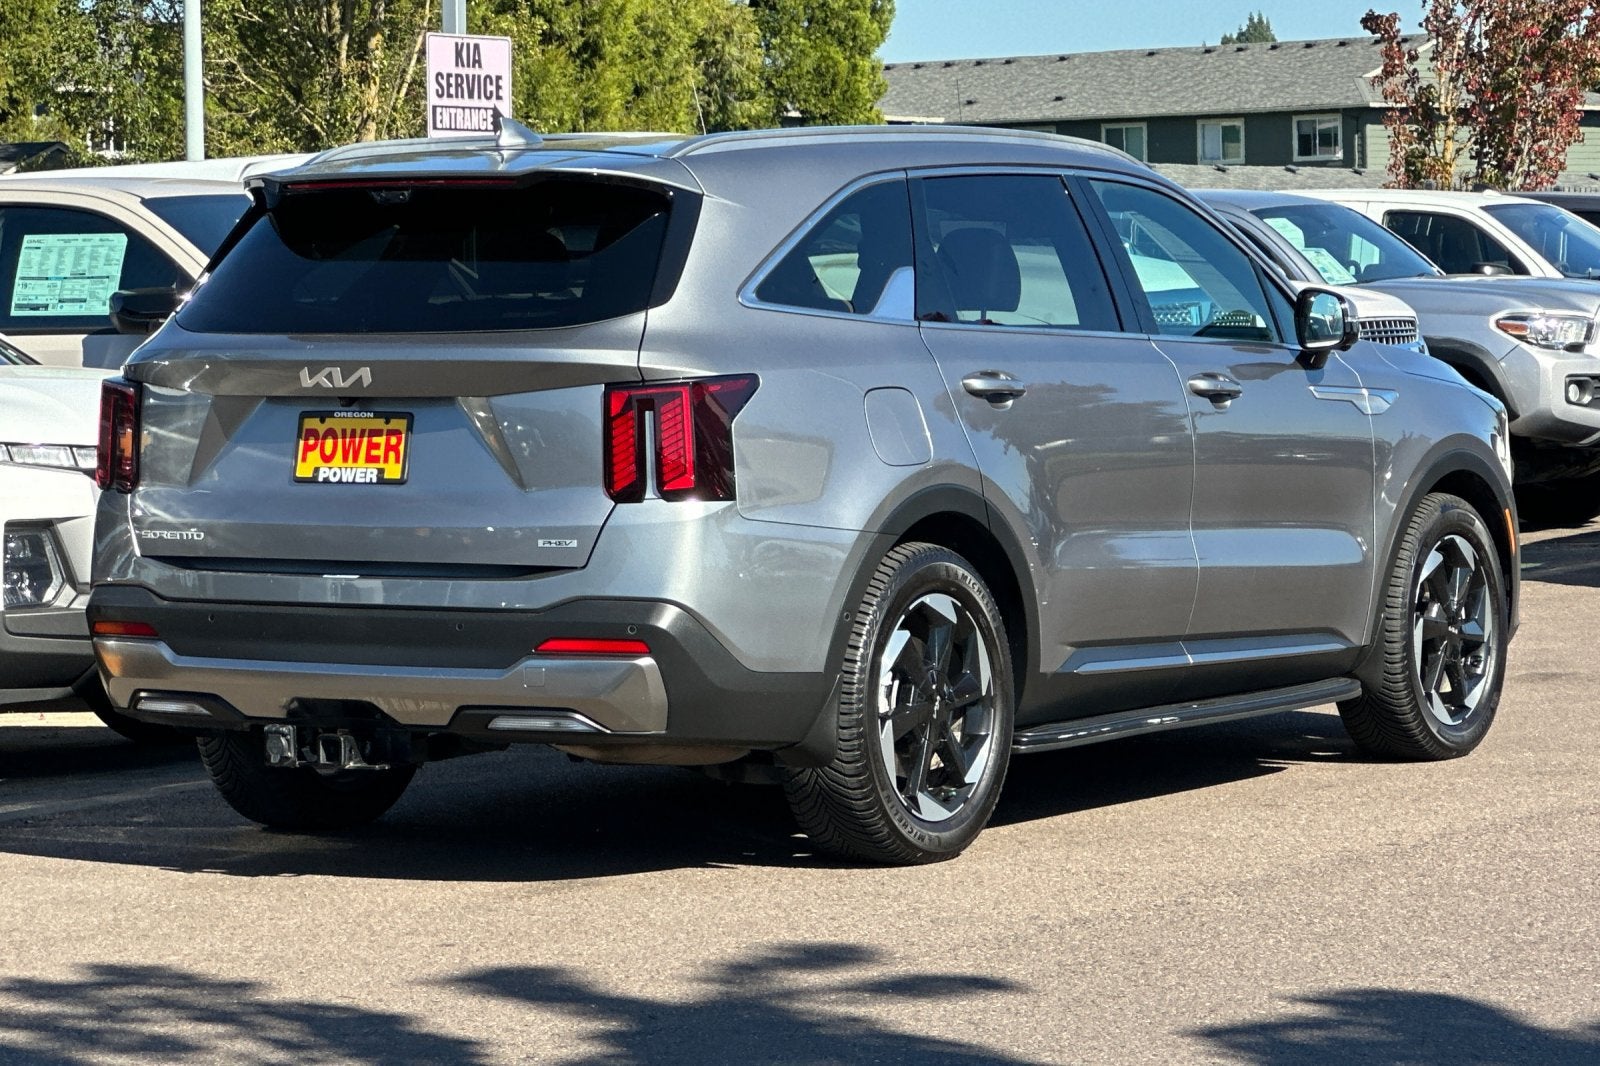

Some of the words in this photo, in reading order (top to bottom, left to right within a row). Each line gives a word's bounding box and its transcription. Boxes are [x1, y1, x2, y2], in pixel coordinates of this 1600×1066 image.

[454, 41, 483, 69] KIA
[435, 71, 504, 101] SERVICE
[435, 106, 494, 131] ENTRANCE
[300, 366, 372, 388] KIA
[301, 427, 404, 465] POWER
[317, 467, 378, 483] POWER
[141, 529, 205, 541] SORENTO
